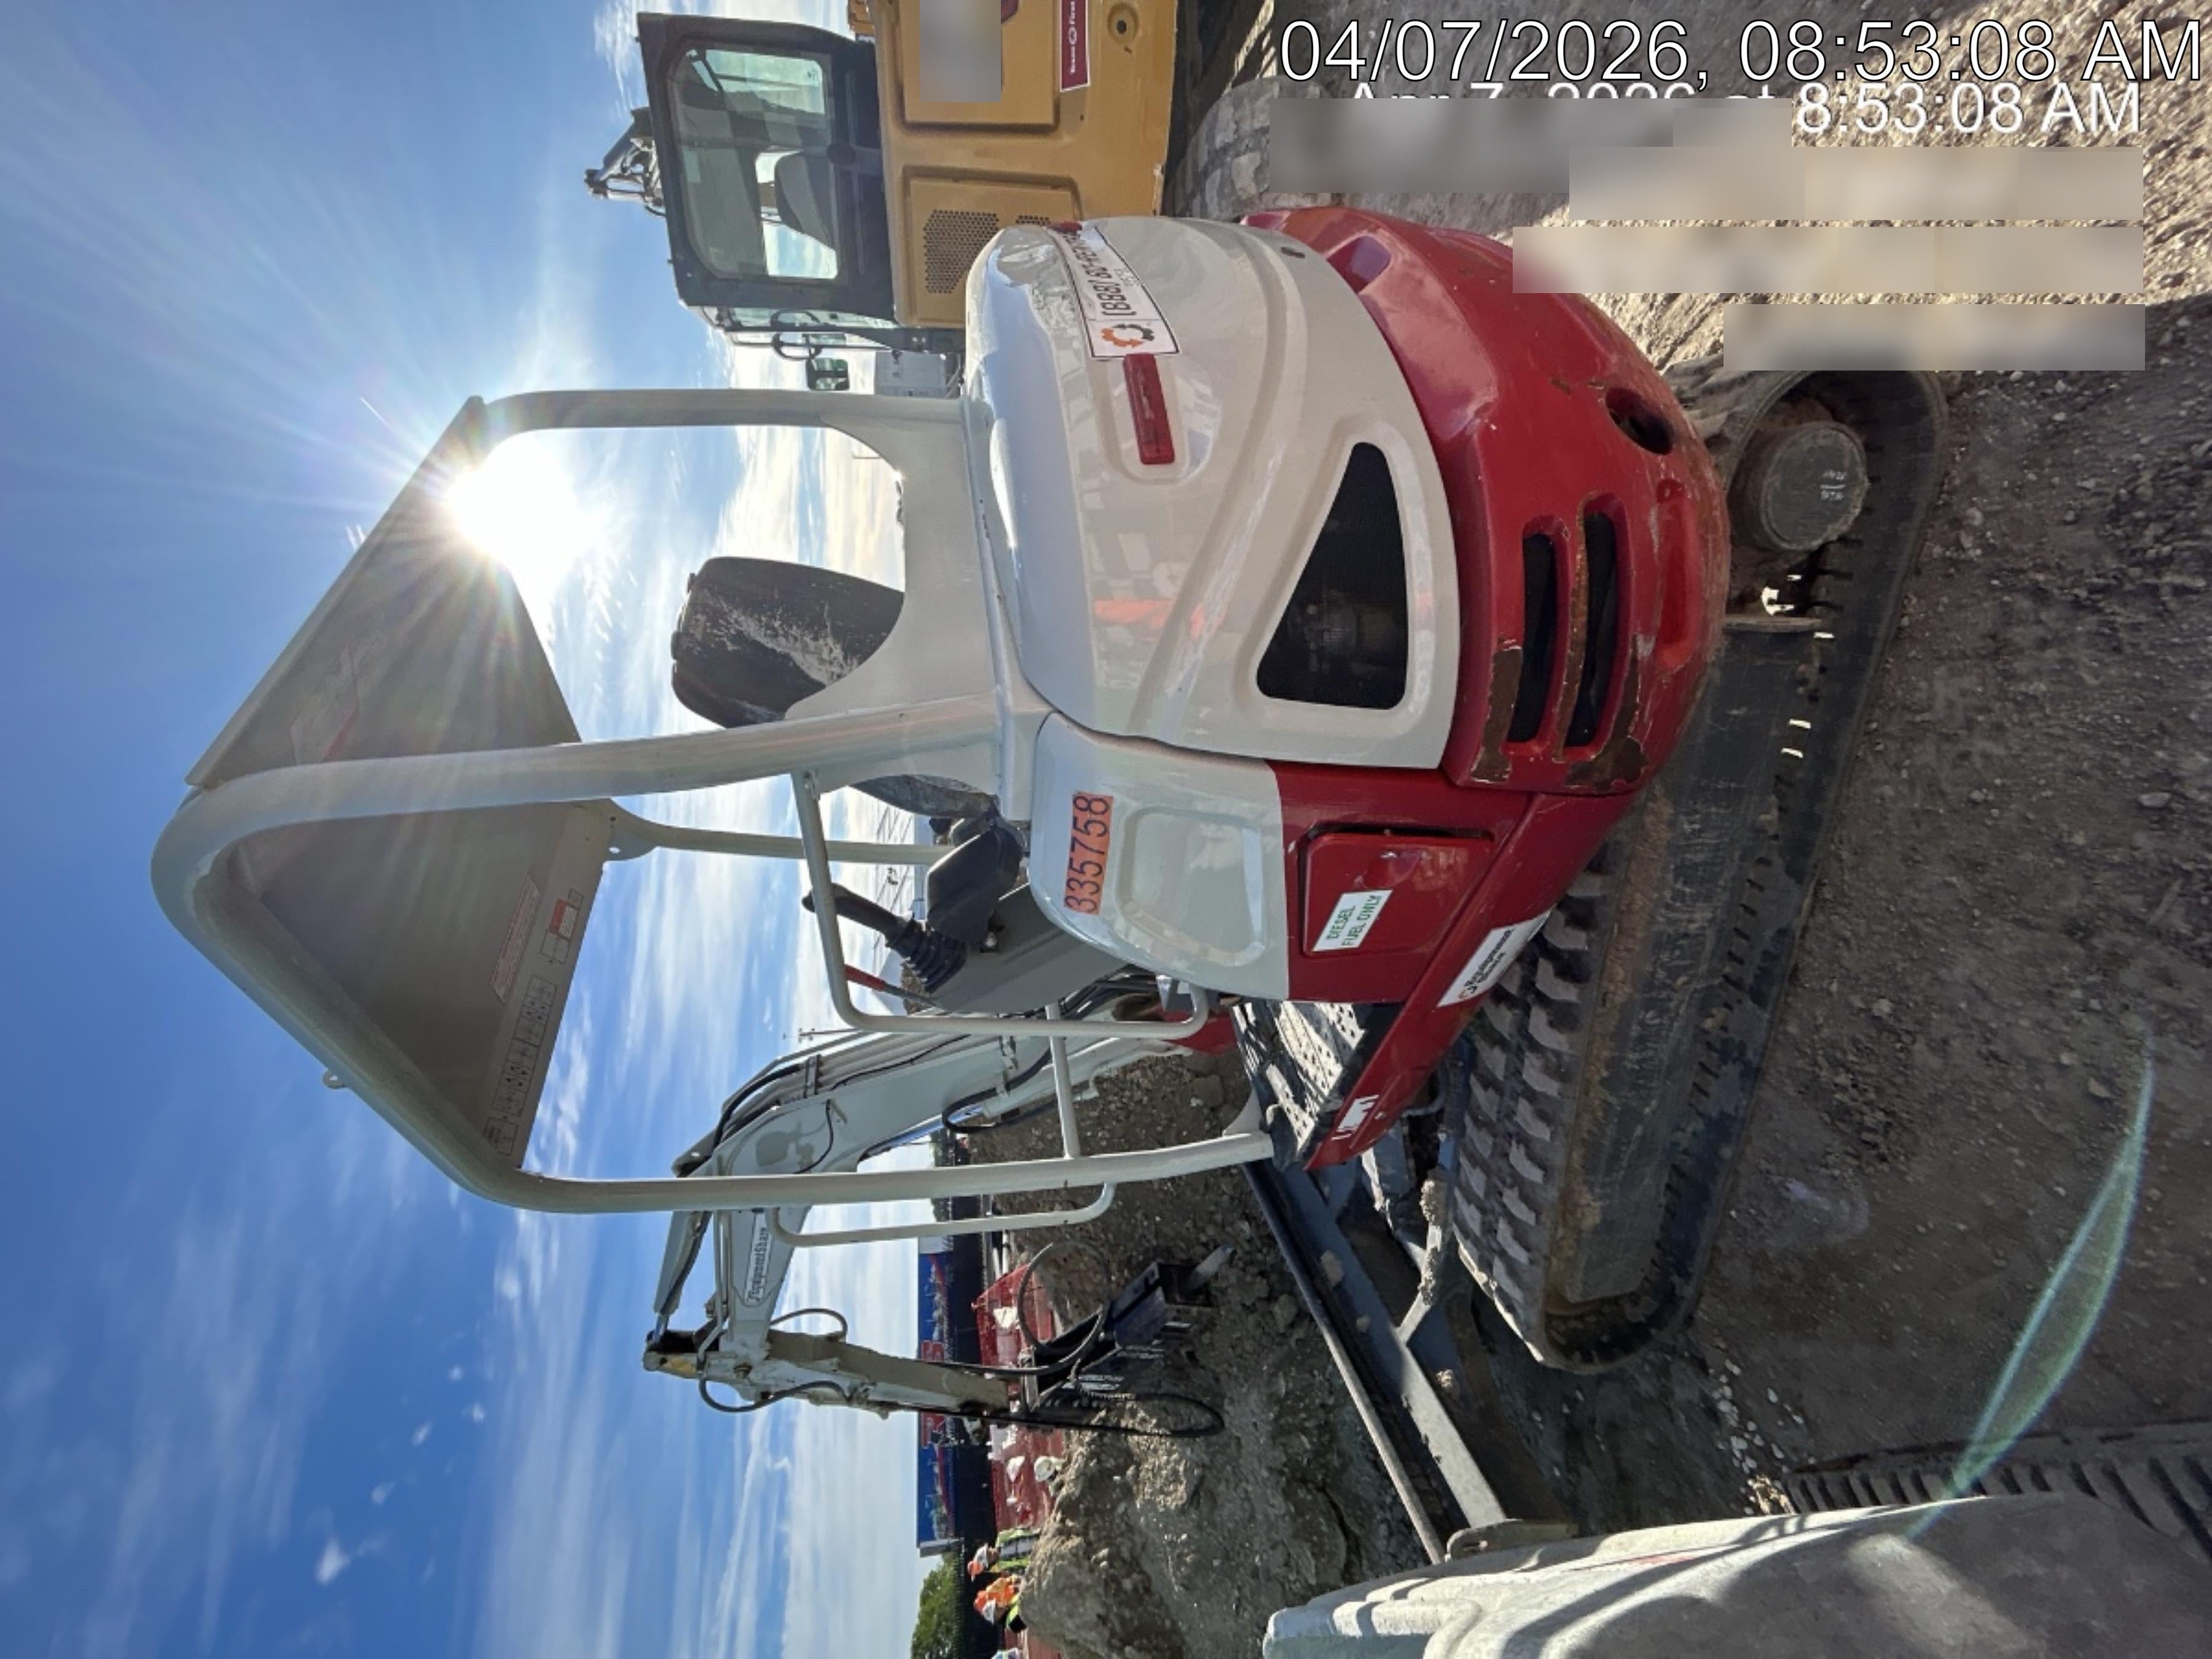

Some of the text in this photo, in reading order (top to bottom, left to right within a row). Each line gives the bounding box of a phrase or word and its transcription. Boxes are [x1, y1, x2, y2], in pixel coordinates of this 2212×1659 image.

[1088, 278, 1136, 316] (888)
[1064, 795, 1109, 913] 335758
[1326, 905, 1355, 939] DIESEL
[1341, 895, 1382, 946] FUEL ONLY
